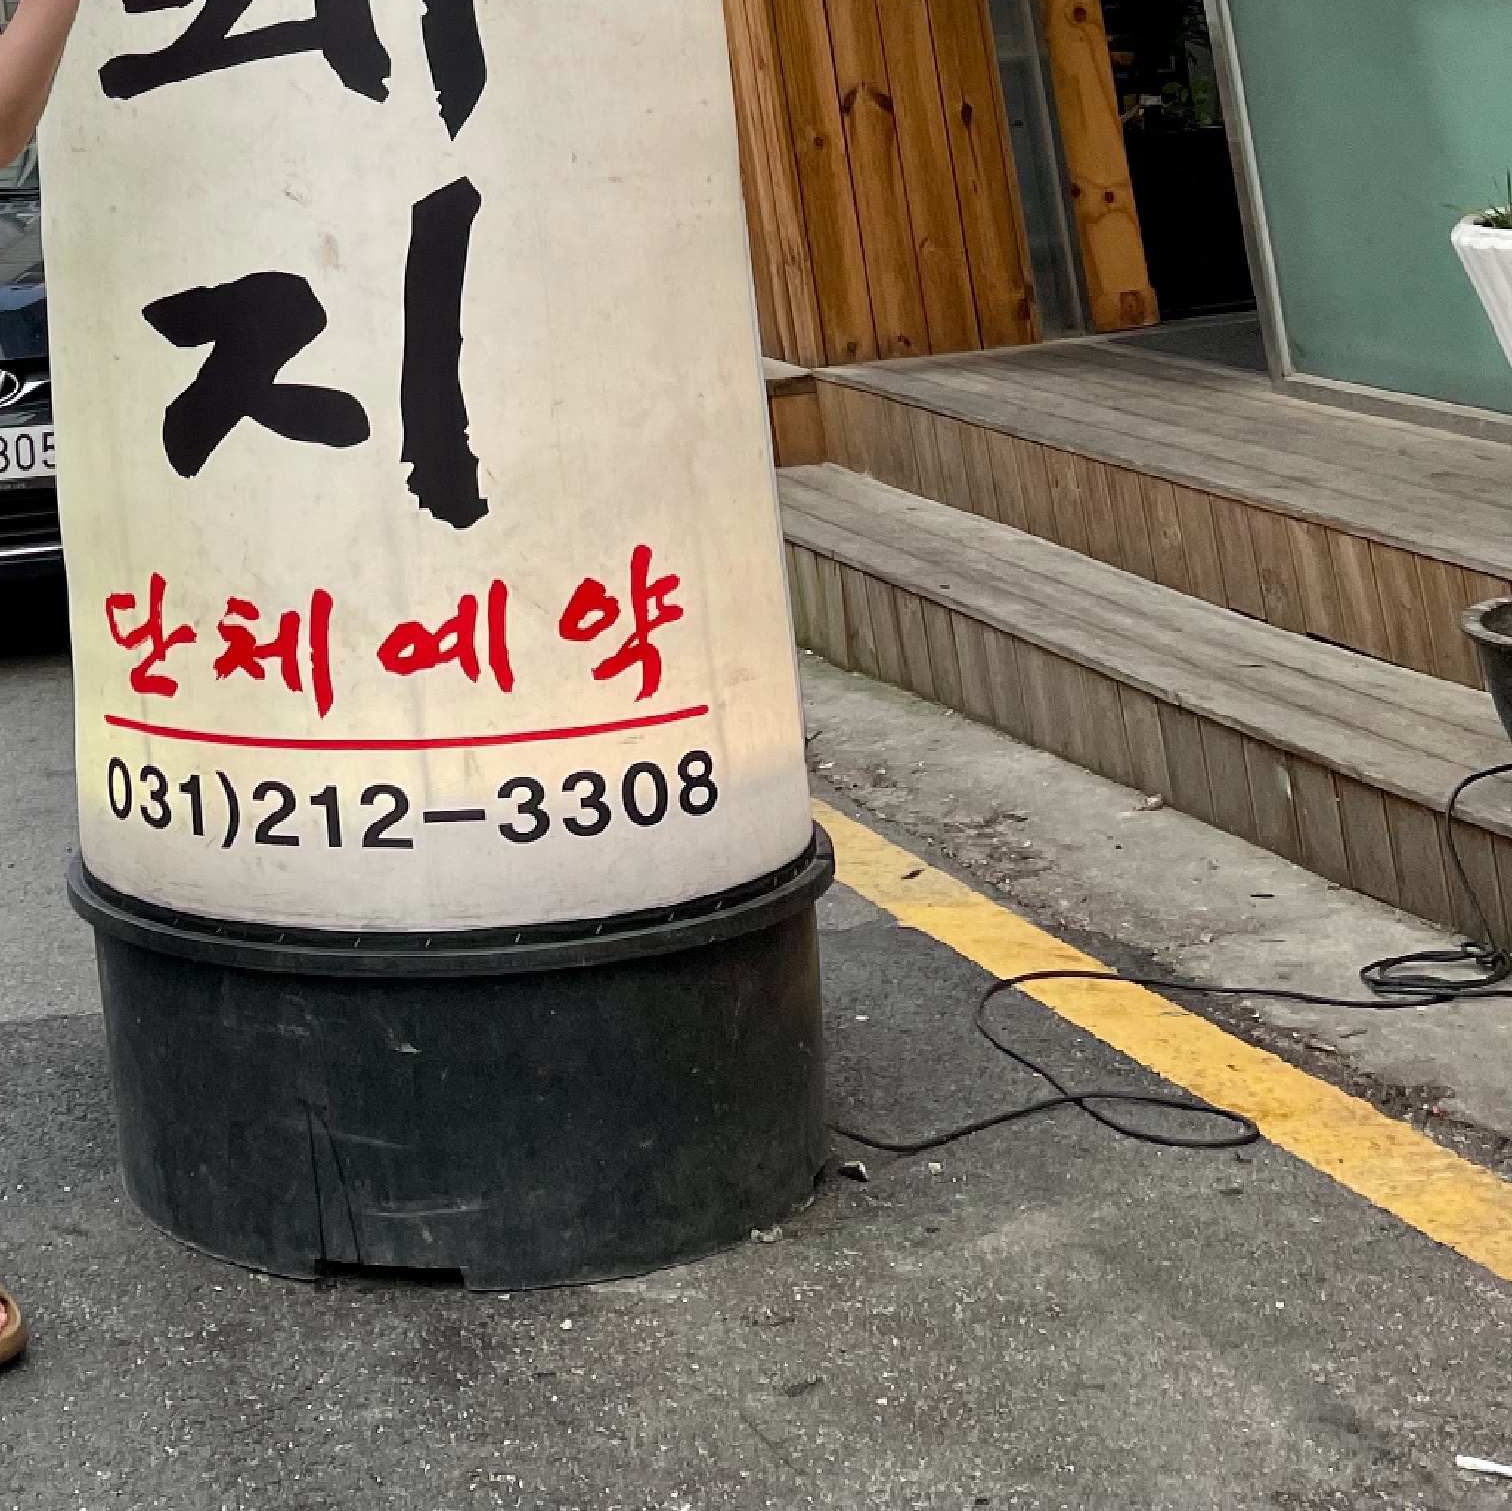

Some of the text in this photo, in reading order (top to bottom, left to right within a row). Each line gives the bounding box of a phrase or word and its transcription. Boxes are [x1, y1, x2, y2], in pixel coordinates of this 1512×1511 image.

[105, 544, 685, 718] 단체 예약
[108, 749, 719, 850] 031)212-3308
